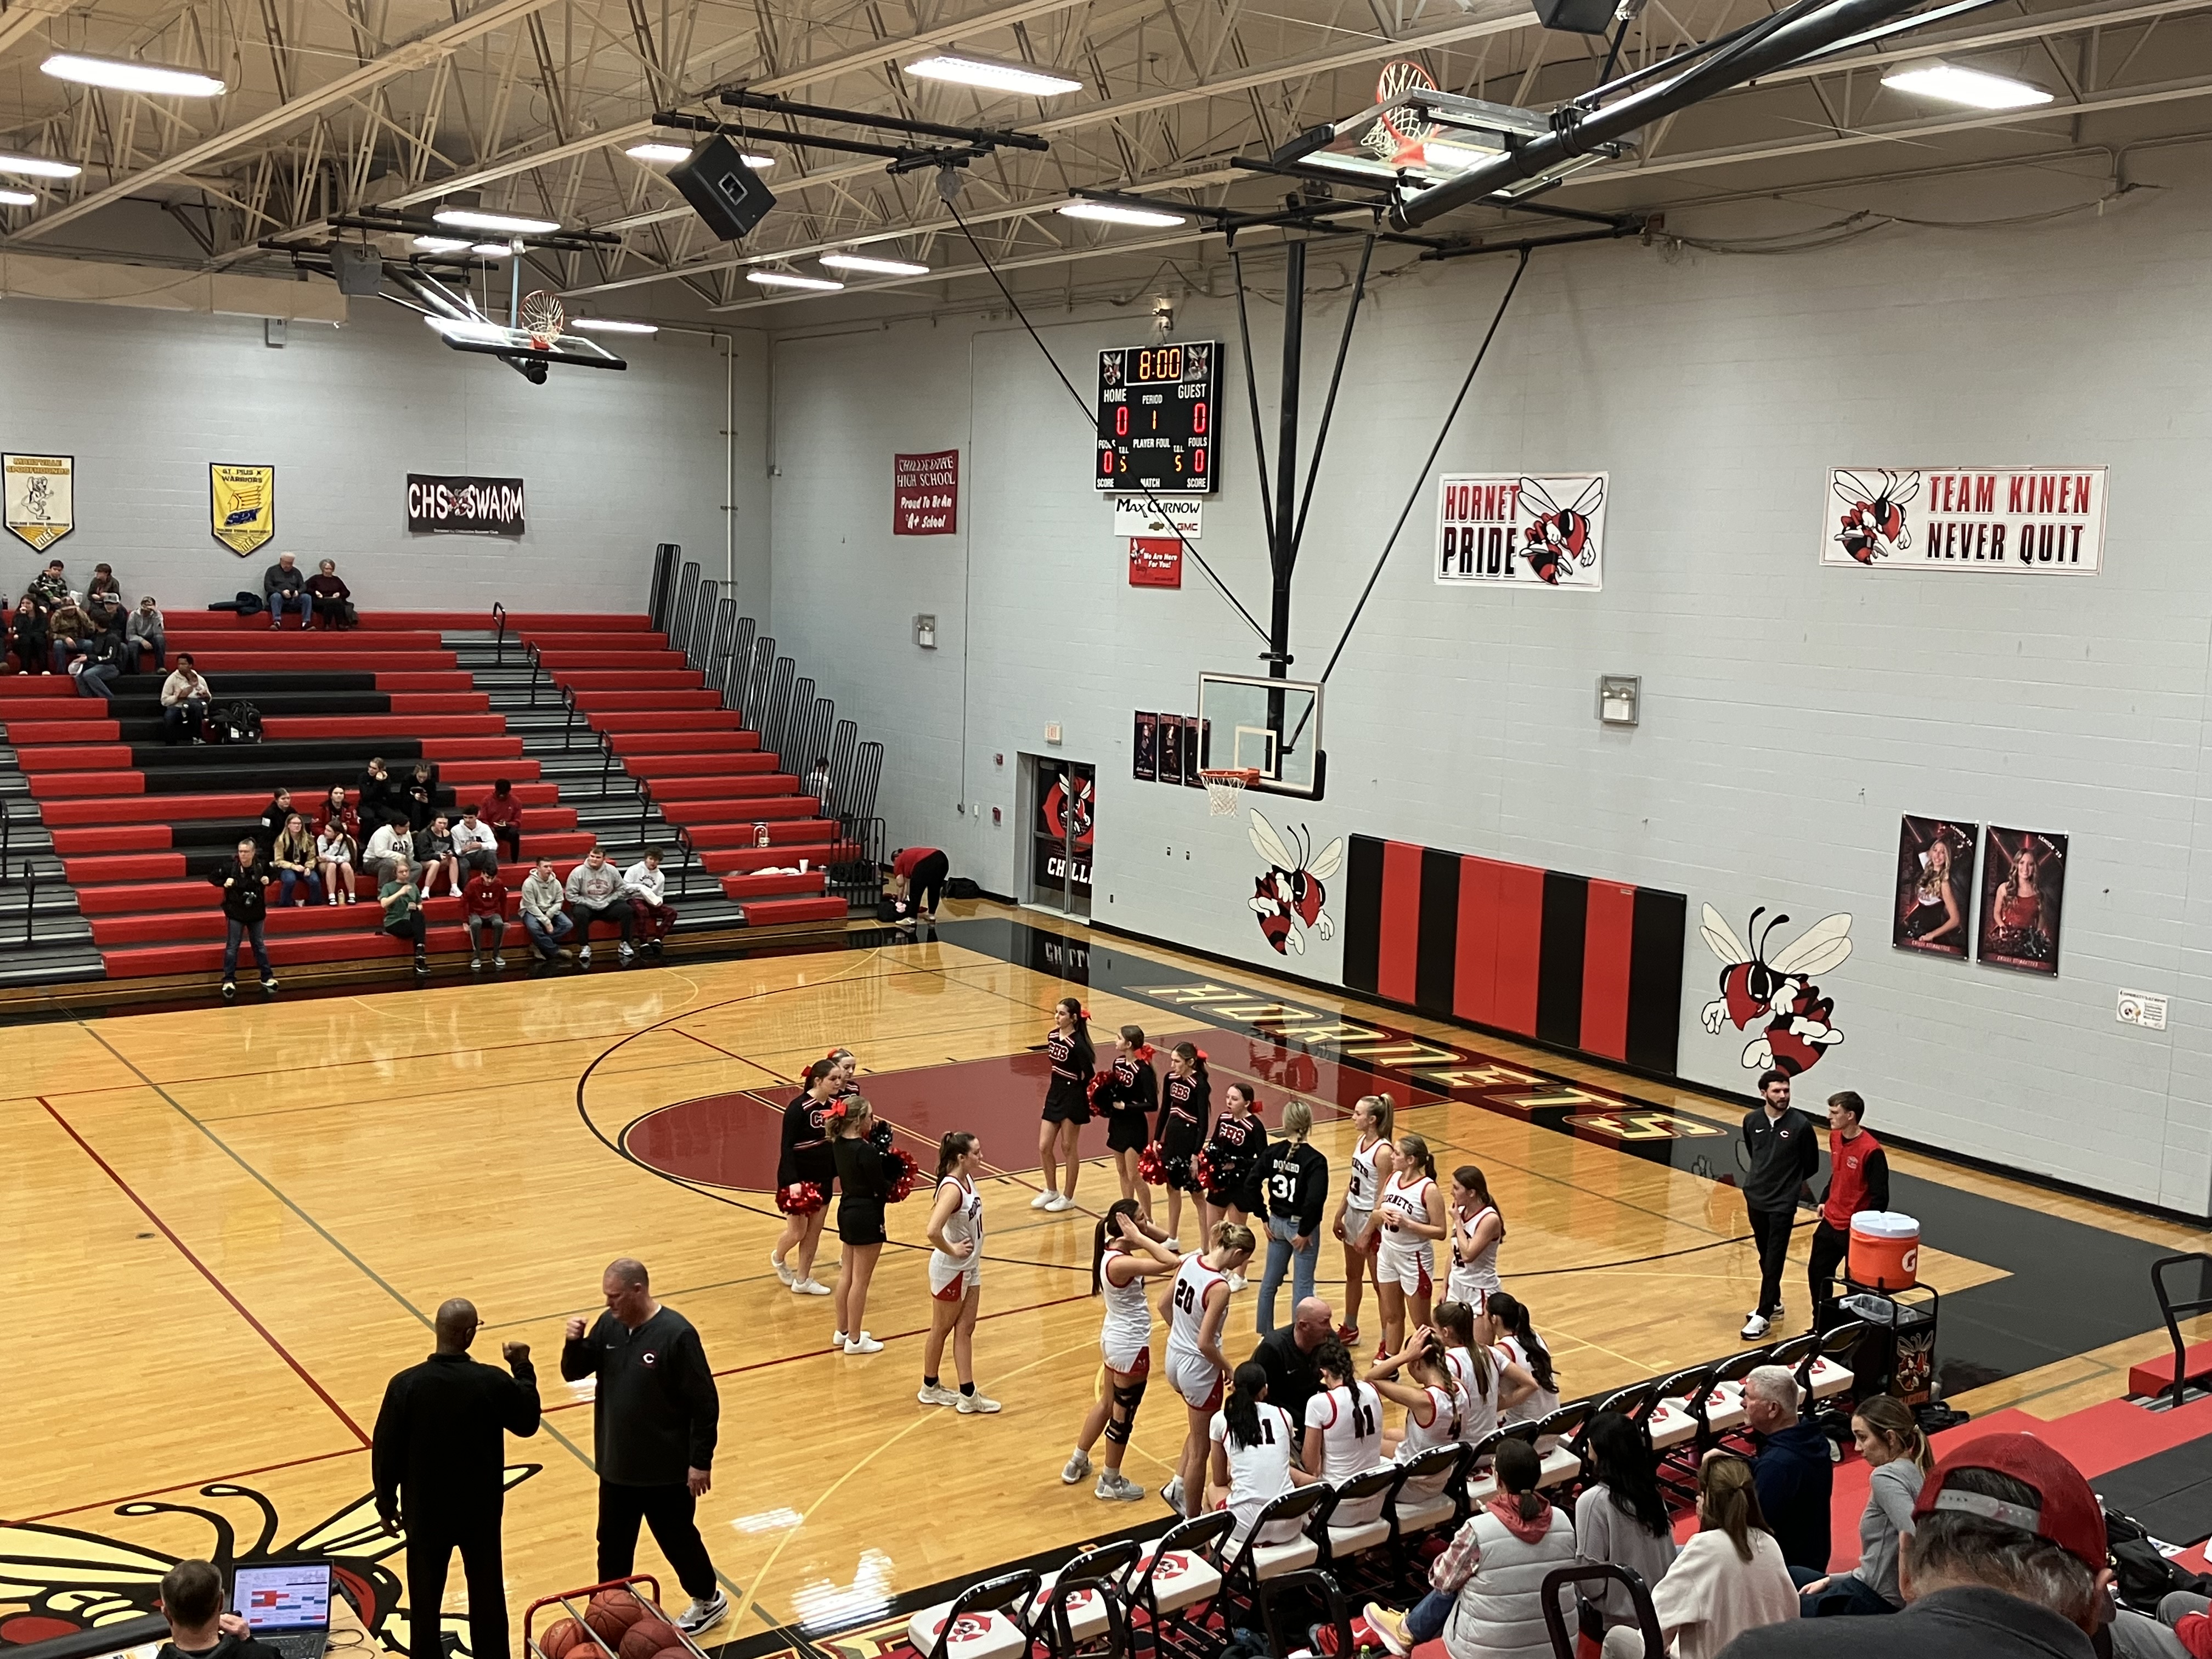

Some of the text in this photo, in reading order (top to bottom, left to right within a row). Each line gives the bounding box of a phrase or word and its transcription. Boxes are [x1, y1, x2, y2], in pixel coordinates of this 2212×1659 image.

[1139, 348, 1180, 380] 8:00
[1103, 388, 1127, 403] HOME
[1142, 394, 1163, 405] PERIOD
[1177, 383, 1206, 399] GUEST
[1116, 406, 1128, 435] 0
[1194, 403, 1206, 433] 0
[1133, 438, 1170, 448] PLAYER FOUL
[1188, 437, 1207, 447] FOULS
[1195, 449, 1204, 472] 0
[896, 471, 955, 488] HIGH SCHOOL
[1097, 478, 1114, 488] SCORE
[1141, 477, 1160, 488] MATCH
[1187, 477, 1206, 488] SCORE
[408, 483, 525, 524] CHS SWARM
[900, 496, 922, 509] Proud
[1444, 484, 1520, 521] HORNET
[1929, 475, 2091, 515] TEAM KINEN
[921, 515, 946, 528] School
[1177, 523, 1198, 531] GMC
[1441, 526, 1517, 575] PRIDE
[1927, 522, 2085, 565] NEVER QUIT
[1272, 1174, 1296, 1203] 31
[1175, 1278, 1195, 1315] 20
